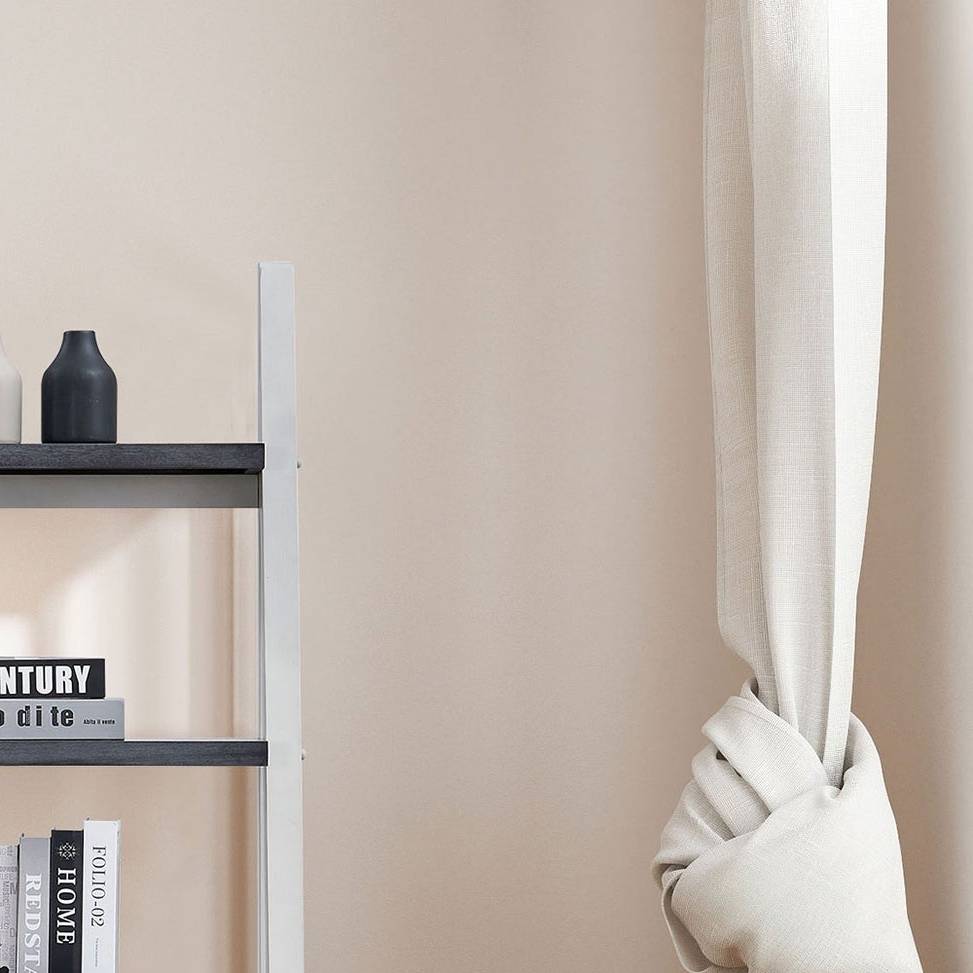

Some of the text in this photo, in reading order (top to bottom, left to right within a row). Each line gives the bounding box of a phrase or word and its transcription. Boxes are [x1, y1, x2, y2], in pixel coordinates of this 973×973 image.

[51, 706, 74, 727] te
[56, 867, 77, 945] HOME
[91, 846, 107, 927] FOLIO-02
